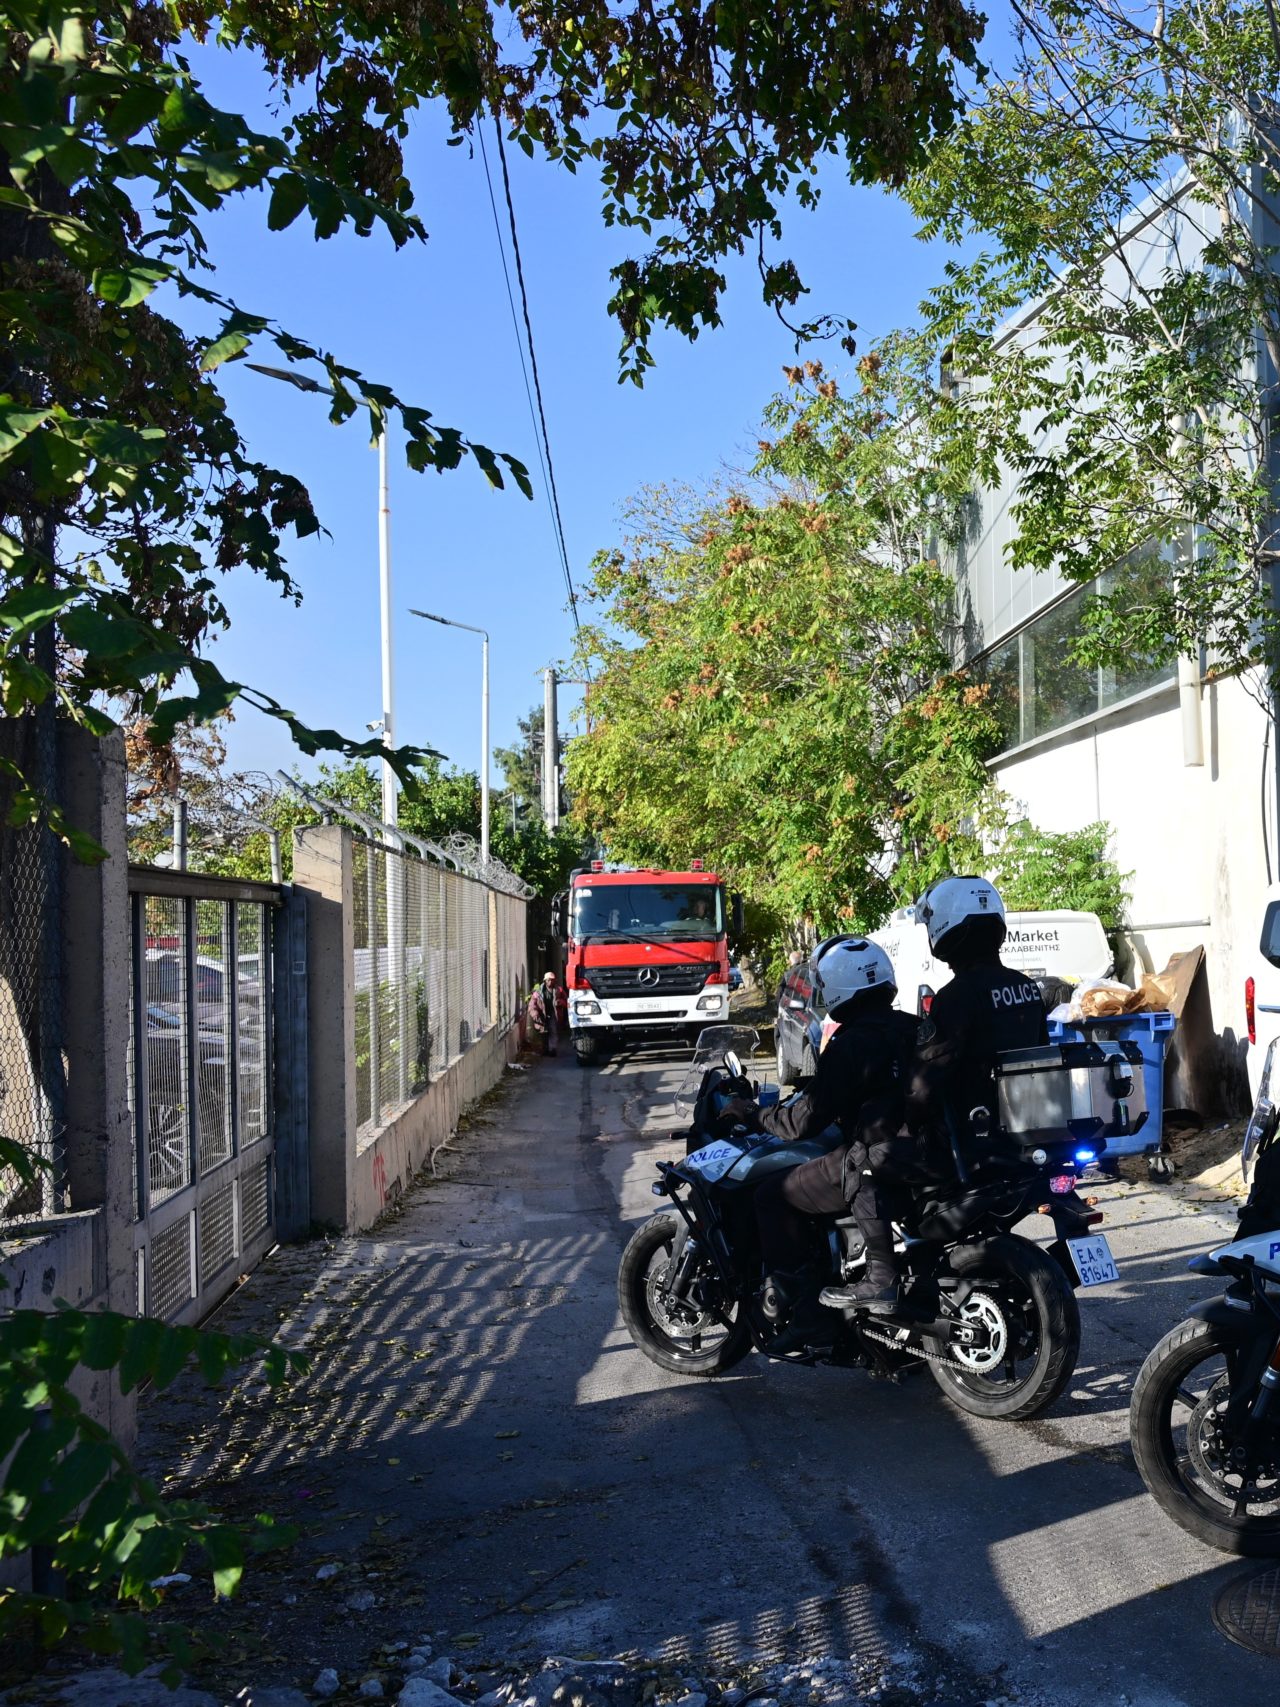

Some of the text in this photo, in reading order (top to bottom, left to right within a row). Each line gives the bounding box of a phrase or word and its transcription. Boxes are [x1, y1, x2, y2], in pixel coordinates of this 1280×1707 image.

[1005, 929, 1060, 943] Market
[991, 982, 1040, 1009] POLICE
[687, 1147, 732, 1166] POLICE
[1080, 1263, 1114, 1283] 81647
